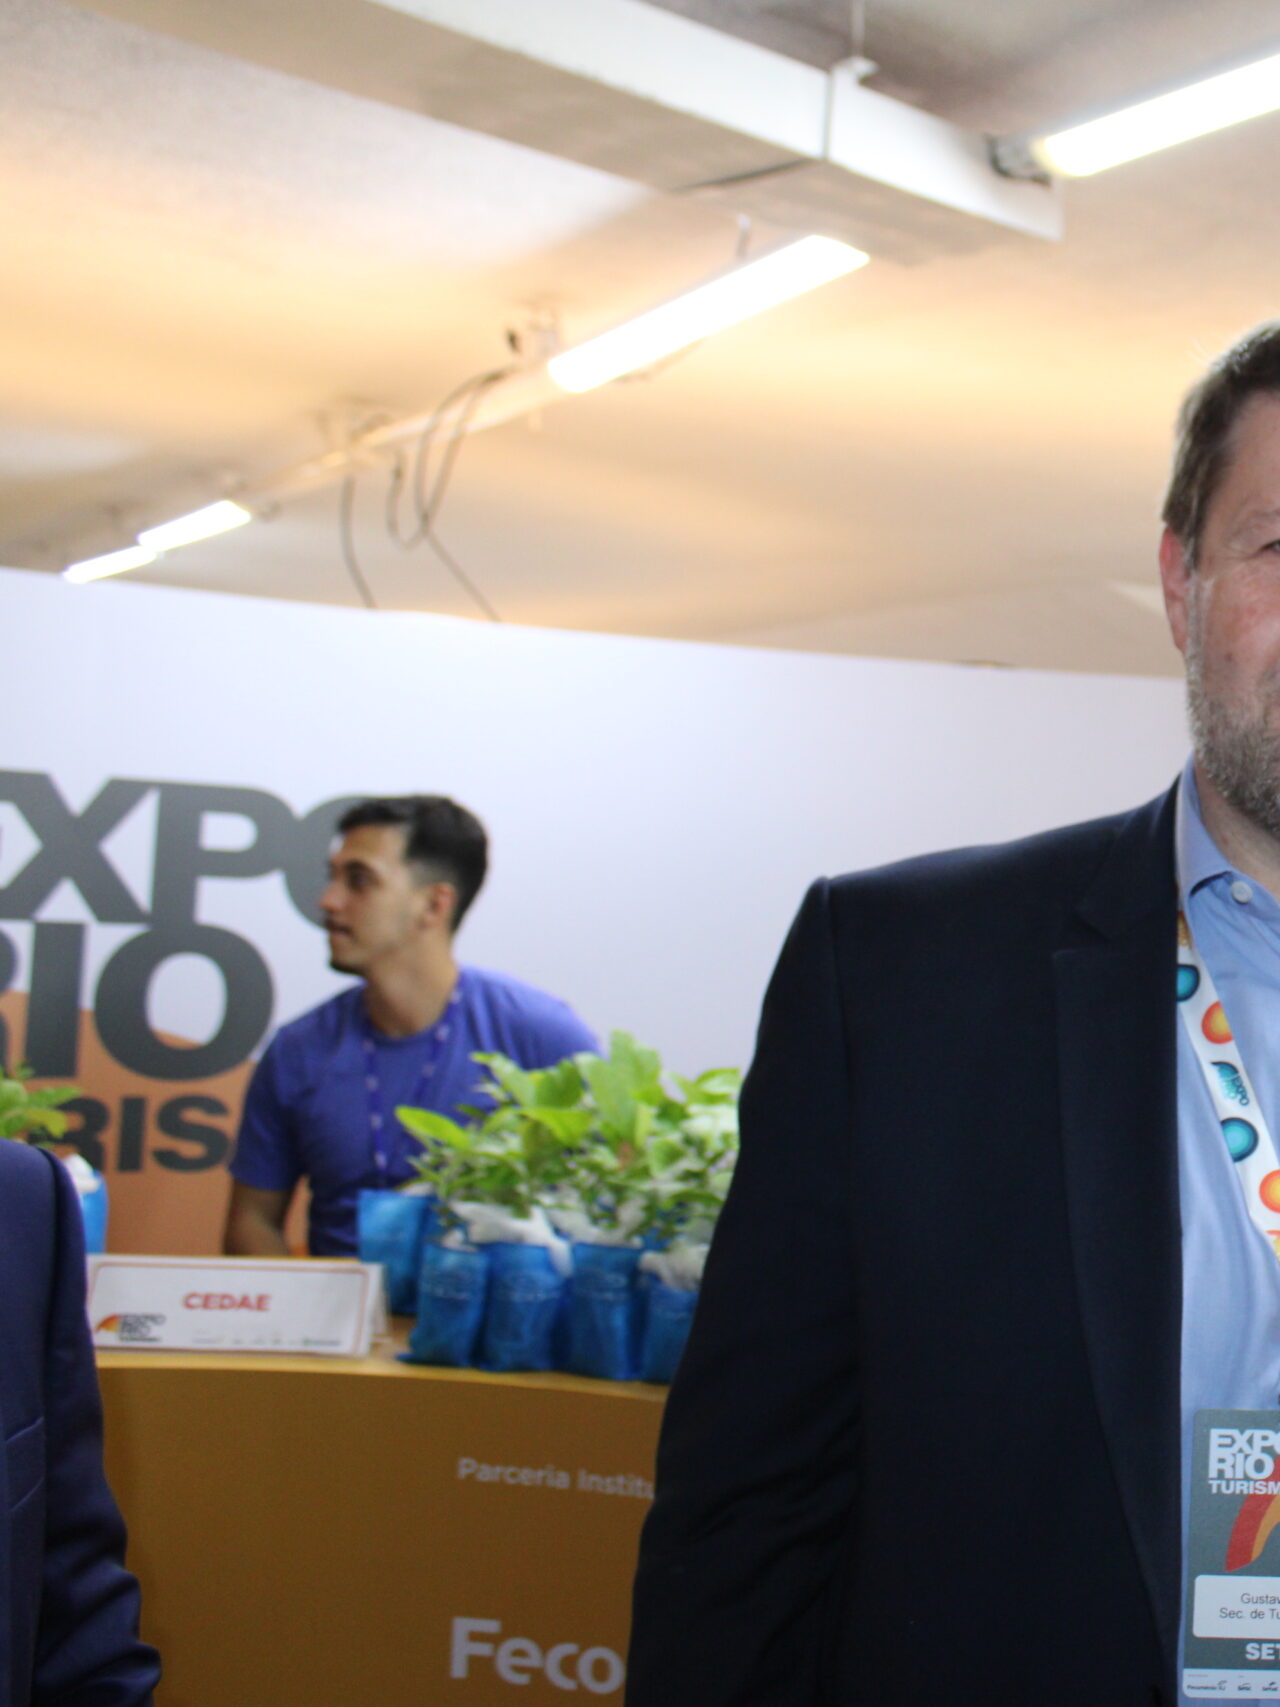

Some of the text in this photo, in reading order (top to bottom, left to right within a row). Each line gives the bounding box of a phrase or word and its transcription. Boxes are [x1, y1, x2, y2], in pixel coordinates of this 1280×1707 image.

[0, 922, 274, 1082] IO
[182, 1292, 272, 1311] CEDAE
[457, 1457, 570, 1489] Parceria
[1207, 1452, 1275, 1480] RIO
[1250, 1608, 1265, 1619] de
